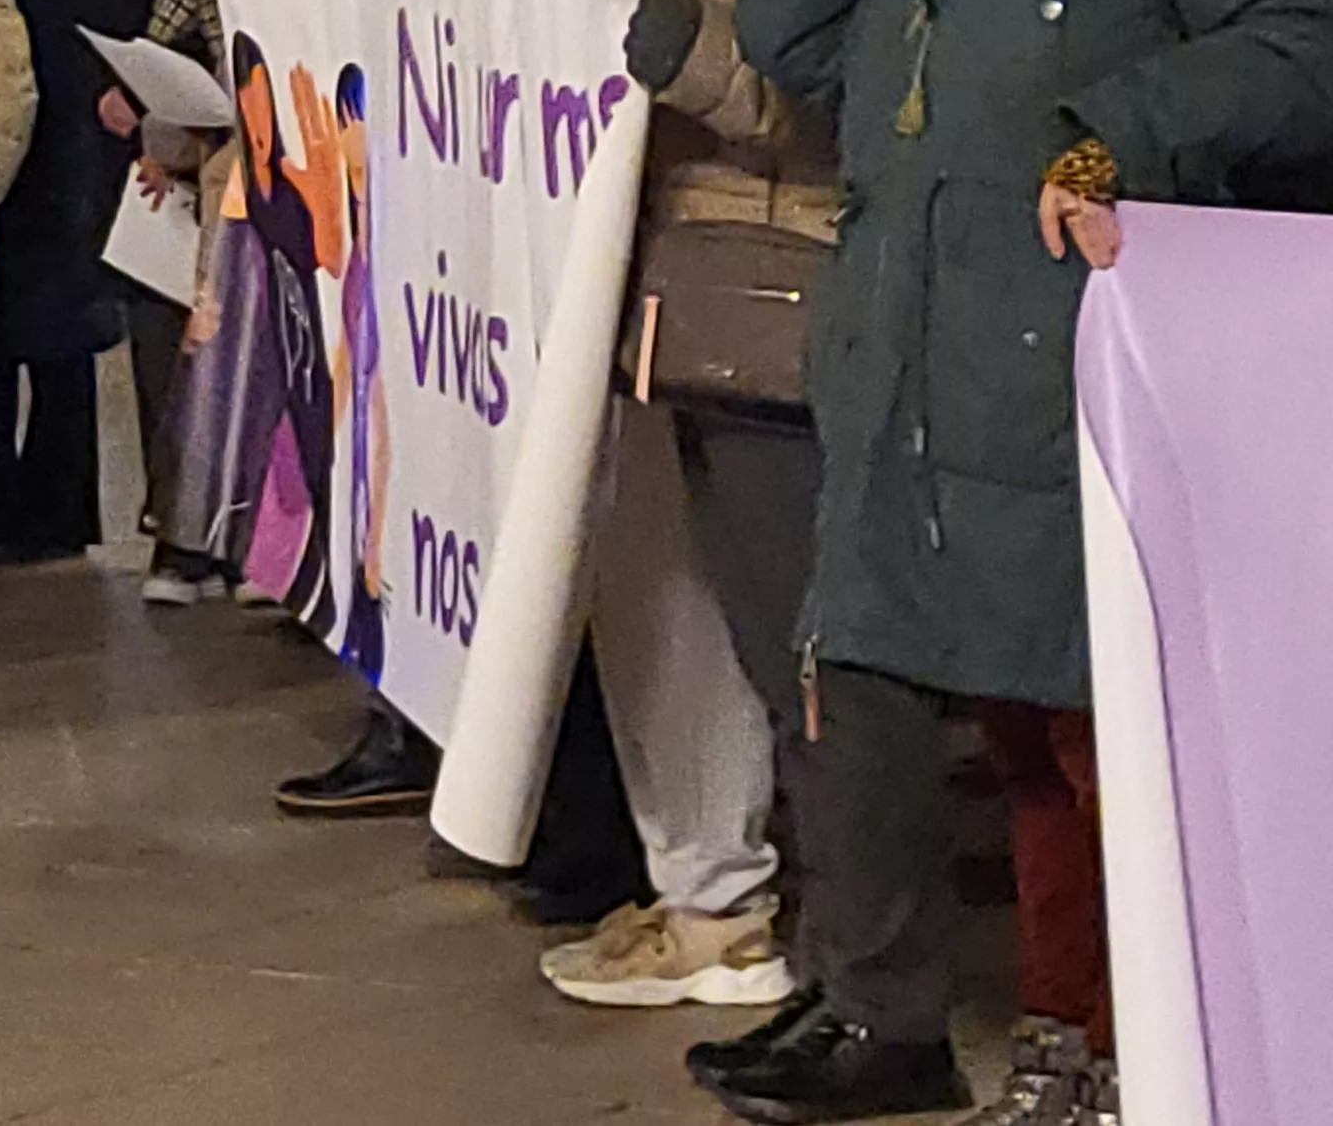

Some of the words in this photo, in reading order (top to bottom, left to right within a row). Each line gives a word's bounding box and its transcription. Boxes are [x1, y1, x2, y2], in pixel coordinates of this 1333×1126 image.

[397, 6, 460, 166] Ni
[403, 249, 510, 428] vivas
[411, 507, 480, 648] nos
